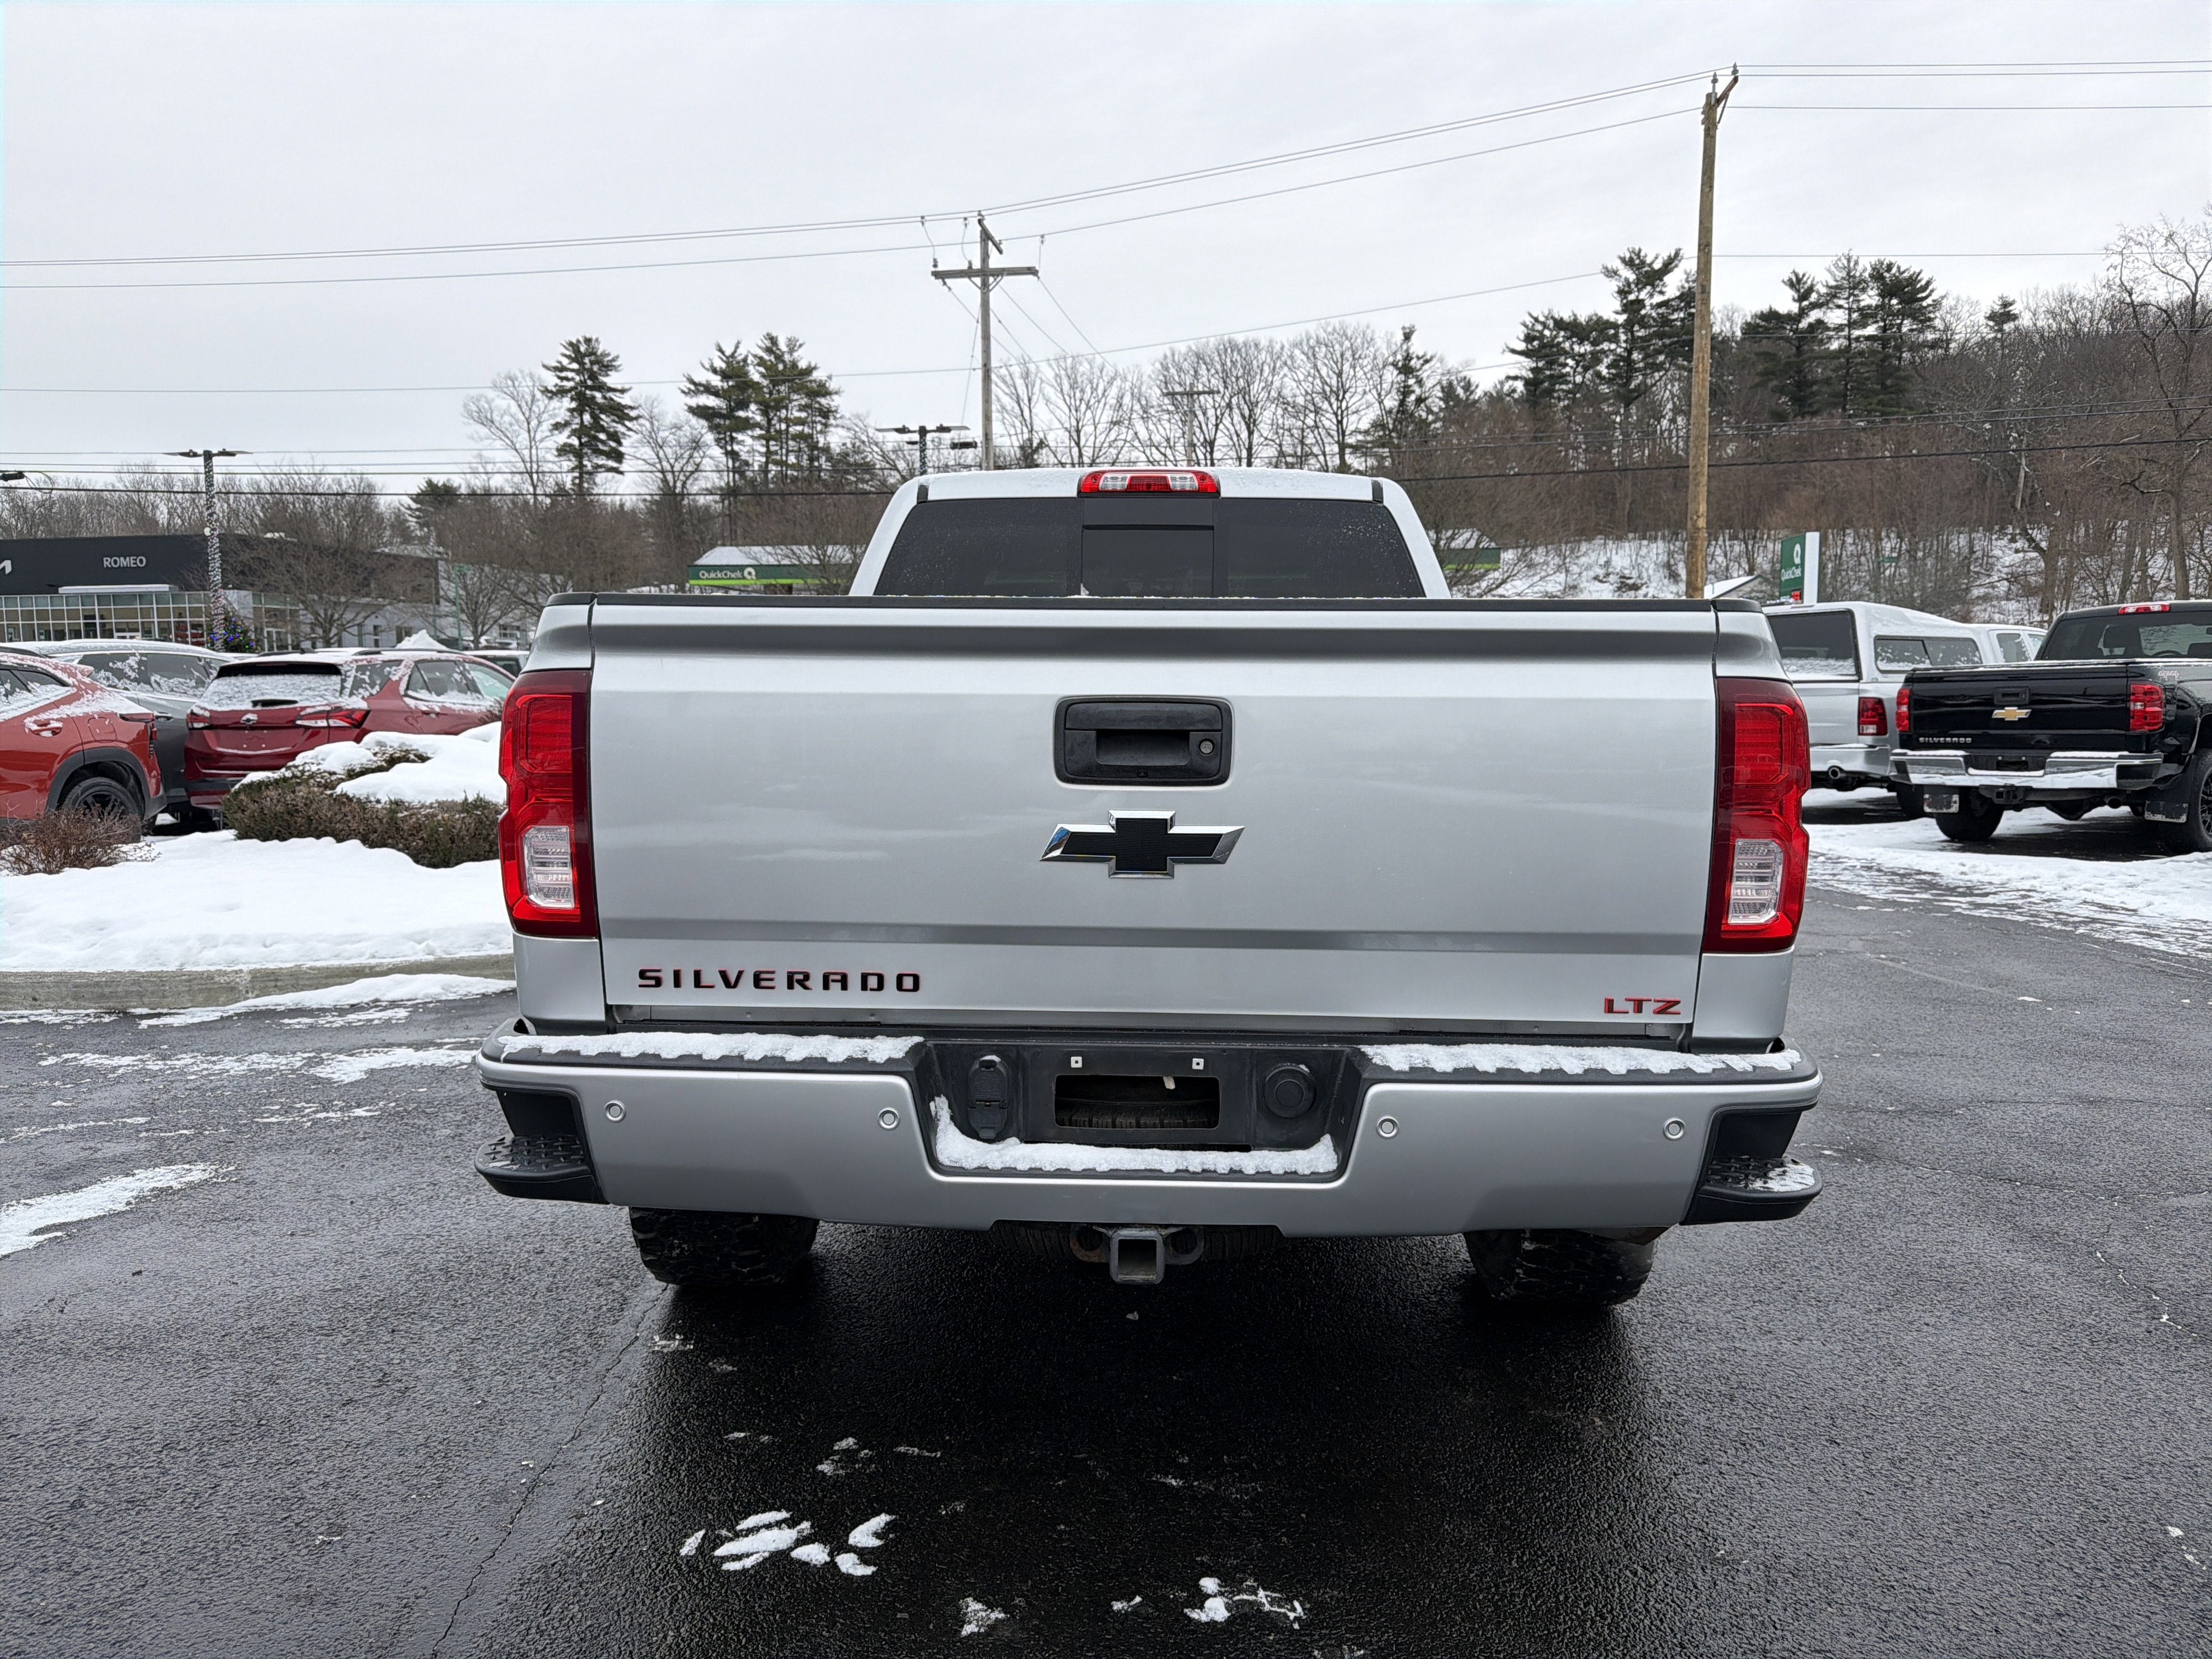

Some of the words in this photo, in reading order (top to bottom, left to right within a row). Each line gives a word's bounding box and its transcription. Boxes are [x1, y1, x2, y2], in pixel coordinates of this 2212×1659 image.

[103, 556, 146, 568] ROMEO
[699, 570, 743, 579] QuickChek
[638, 968, 921, 992] SILVERADO
[1604, 997, 1681, 1014] LTZ
